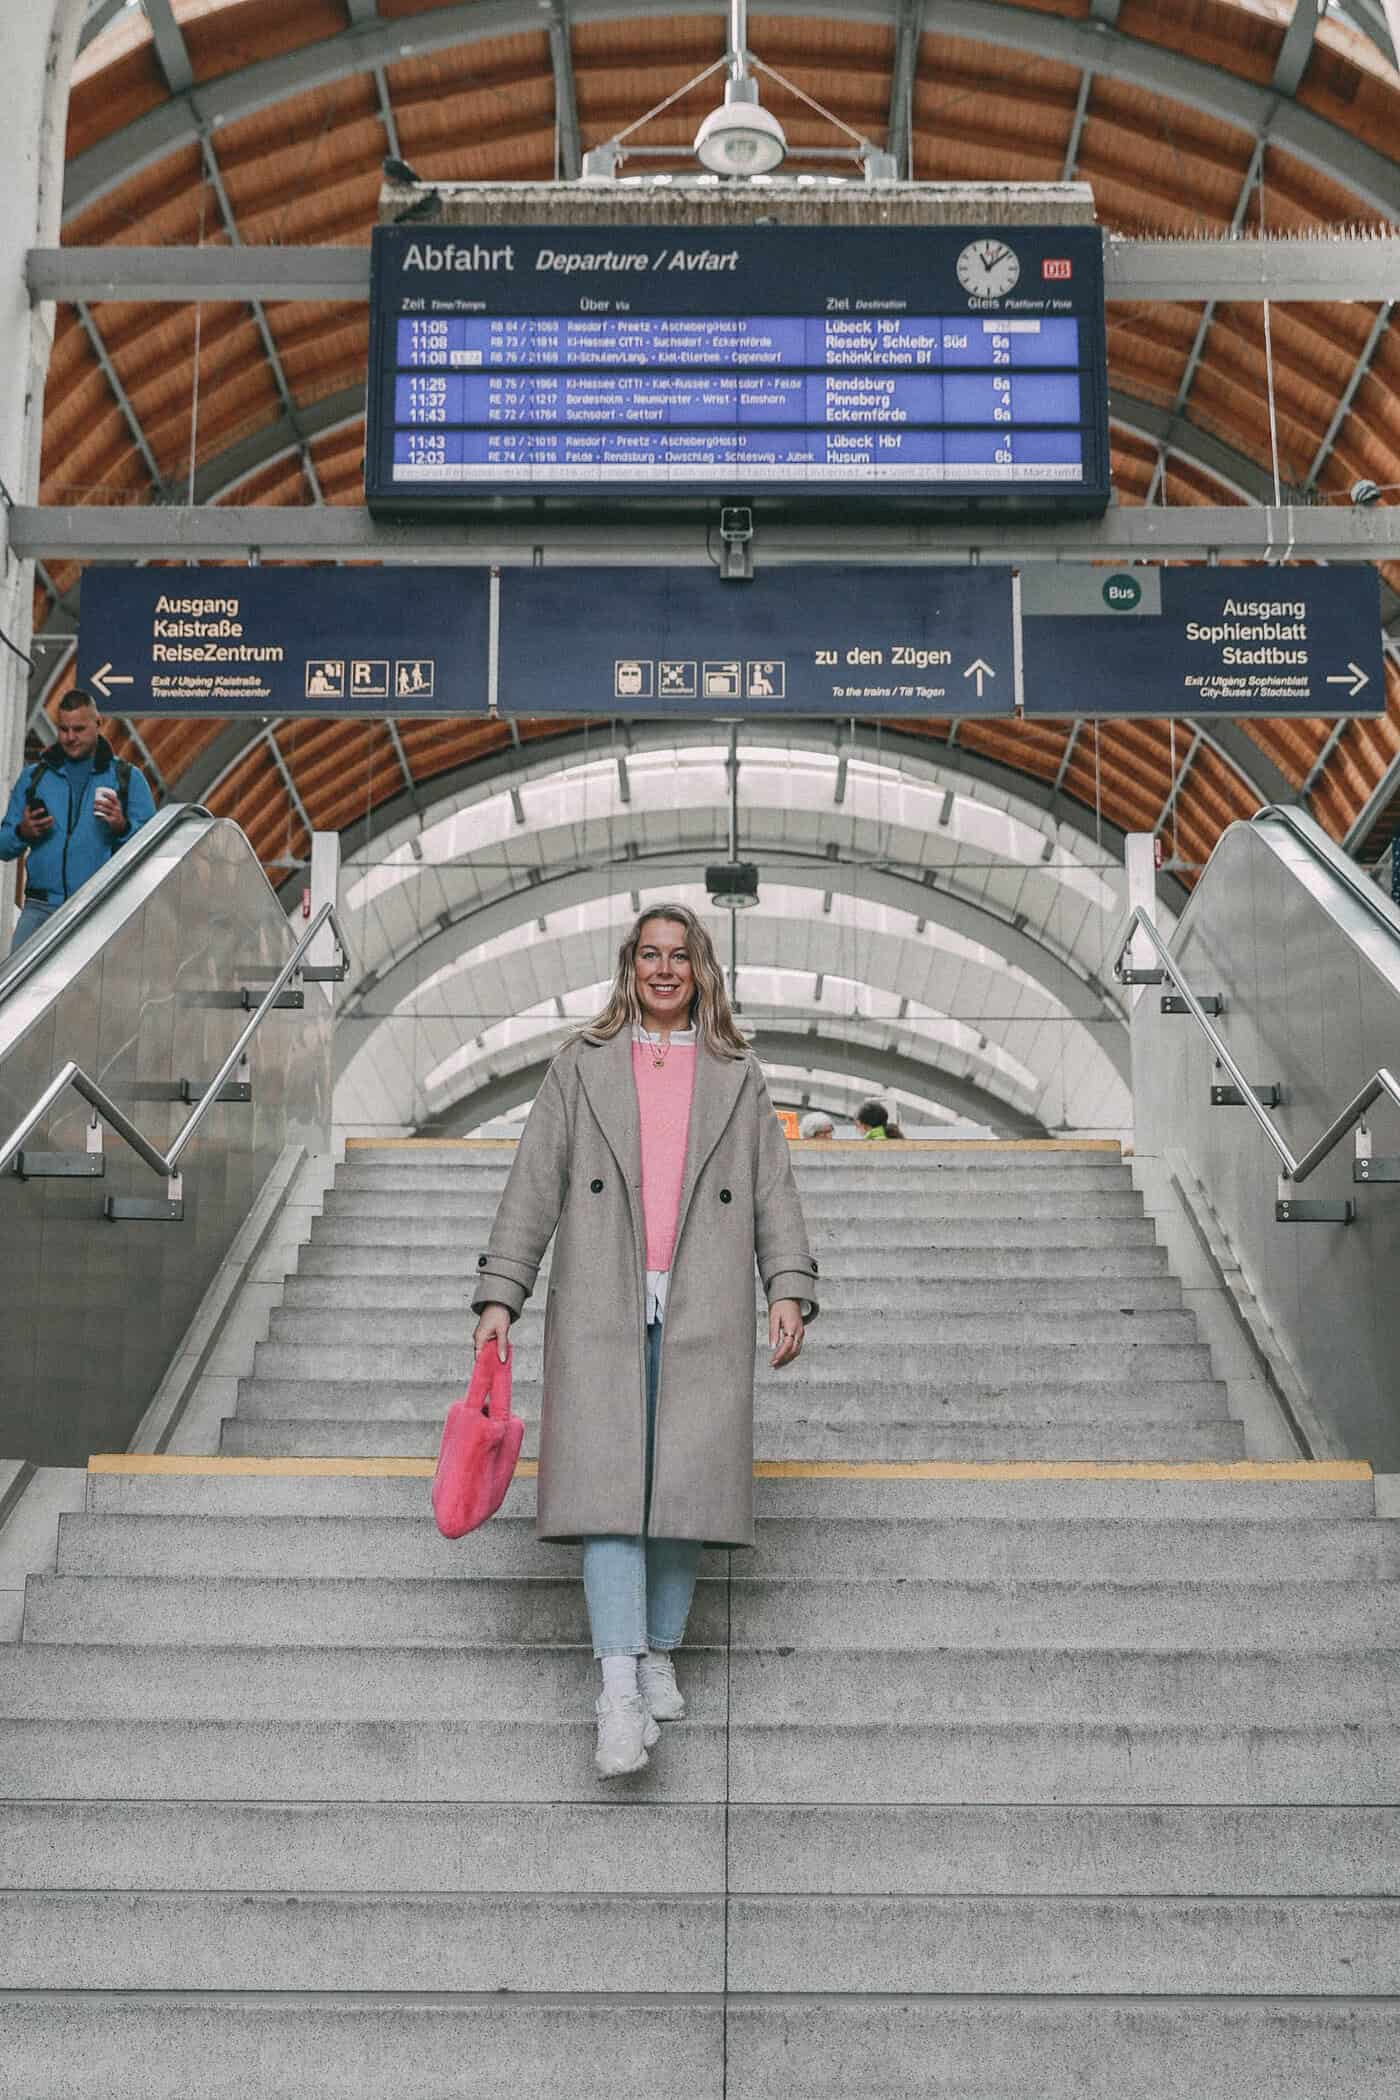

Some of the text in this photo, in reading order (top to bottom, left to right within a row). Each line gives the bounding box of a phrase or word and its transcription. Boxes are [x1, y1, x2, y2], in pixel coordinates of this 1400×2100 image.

[402, 245, 739, 273] Abfahrt Departure / Avfart
[1043, 260, 1071, 278] DB
[402, 298, 425, 310] Zeit
[580, 296, 609, 310] Über
[826, 297, 906, 309] Ziel Destination
[968, 297, 999, 309] Gleis
[412, 320, 448, 334] 11:05
[825, 320, 900, 333] Lübeck Hbf
[825, 335, 967, 350] Rieseby Schleibr. Süd
[825, 350, 931, 364] Schönkirchen Bf
[410, 377, 446, 391] 11:25
[826, 377, 895, 393] Rendsburg
[410, 393, 447, 407] 11:37
[826, 392, 890, 408] Pinneberg
[1001, 393, 1010, 406] 4
[409, 408, 446, 422] 11:43
[826, 408, 906, 421] Eckernförde
[409, 435, 445, 449] 11:43
[826, 434, 901, 448] Lübeck Hbf
[1003, 435, 1010, 447] 1
[408, 451, 445, 464] 12:03
[826, 451, 869, 463] Husum
[1109, 586, 1134, 599] Bus
[155, 595, 238, 616] Ausgang
[1223, 600, 1305, 619] Ausgang
[153, 620, 243, 637] Kaistraße
[1186, 623, 1306, 642] Sophienblatt
[152, 644, 283, 661] ReiseZentrum
[815, 647, 952, 668] zu den Zügen
[1222, 647, 1308, 664] Stadtbus
[355, 663, 371, 684] R
[152, 676, 170, 686] Exit
[1184, 676, 1203, 686] Exit
[1248, 676, 1308, 687] Sophienblatt
[832, 687, 844, 696] To
[846, 687, 862, 696] the
[864, 687, 890, 696] trains
[899, 687, 914, 696] Till
